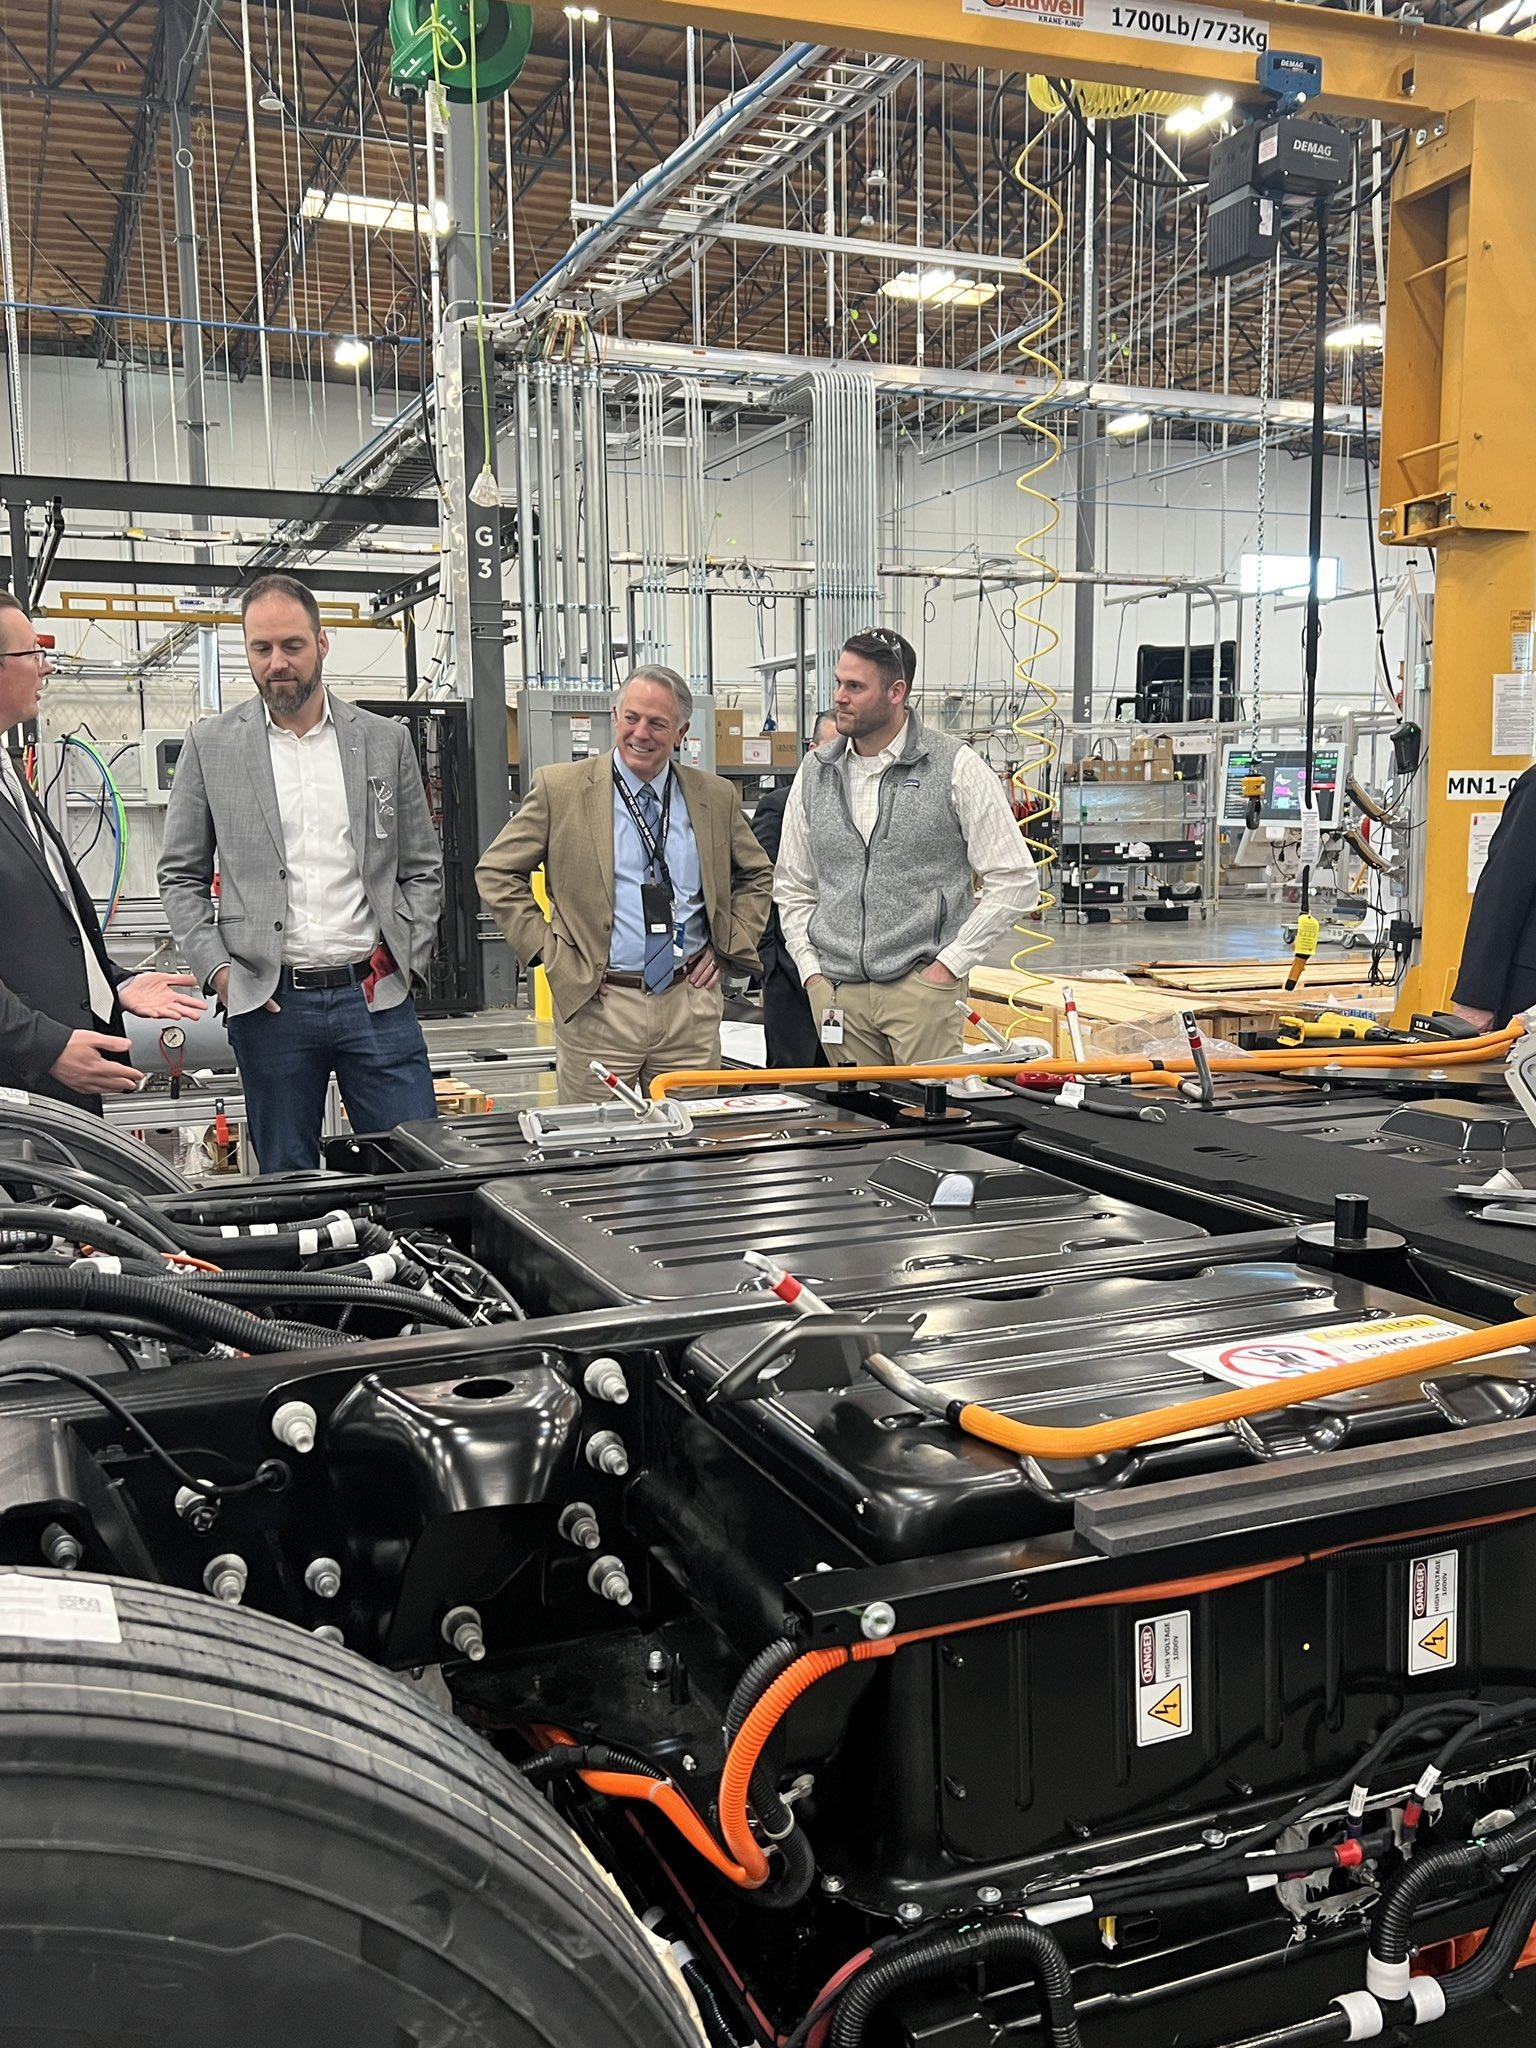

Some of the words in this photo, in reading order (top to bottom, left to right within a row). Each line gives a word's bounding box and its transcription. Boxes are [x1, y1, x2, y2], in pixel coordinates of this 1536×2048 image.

[1112, 7, 1268, 52] 1700Lb/773Kg
[1281, 60, 1304, 68] DEMAG
[1293, 139, 1332, 156] DEMAG
[475, 526, 493, 547] G
[478, 558, 492, 578] 3
[1339, 1319, 1429, 1338] CAUTION
[1353, 1343, 1380, 1351] Do
[1380, 1335, 1418, 1346] NOT
[1416, 1567, 1425, 1611] DANGER
[1163, 1622, 1171, 1657] VOLTAGE
[1143, 1631, 1153, 1679] DANGER
